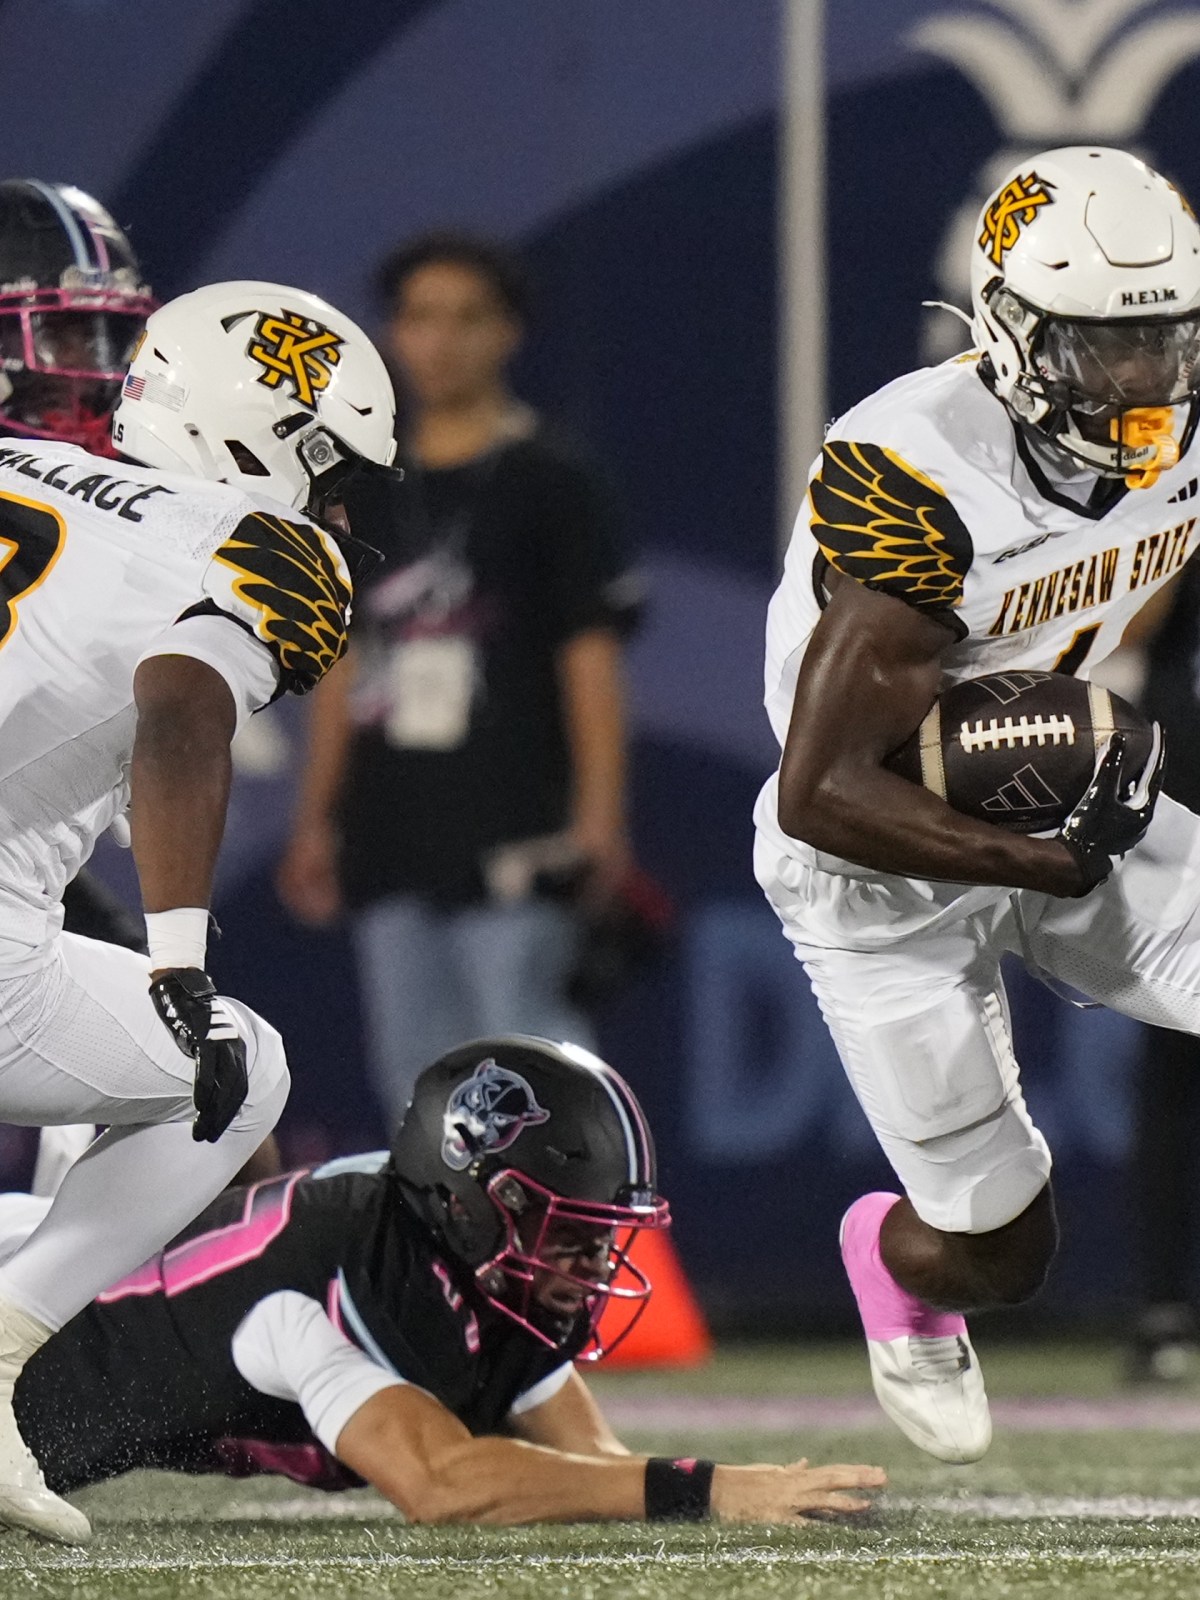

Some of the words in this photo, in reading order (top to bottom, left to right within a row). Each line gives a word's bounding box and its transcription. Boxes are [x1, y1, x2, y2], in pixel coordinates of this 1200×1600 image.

[1110, 447, 1149, 462] Rddell
[988, 547, 1120, 636] KENNESAW
[1128, 516, 1199, 592] STATE
